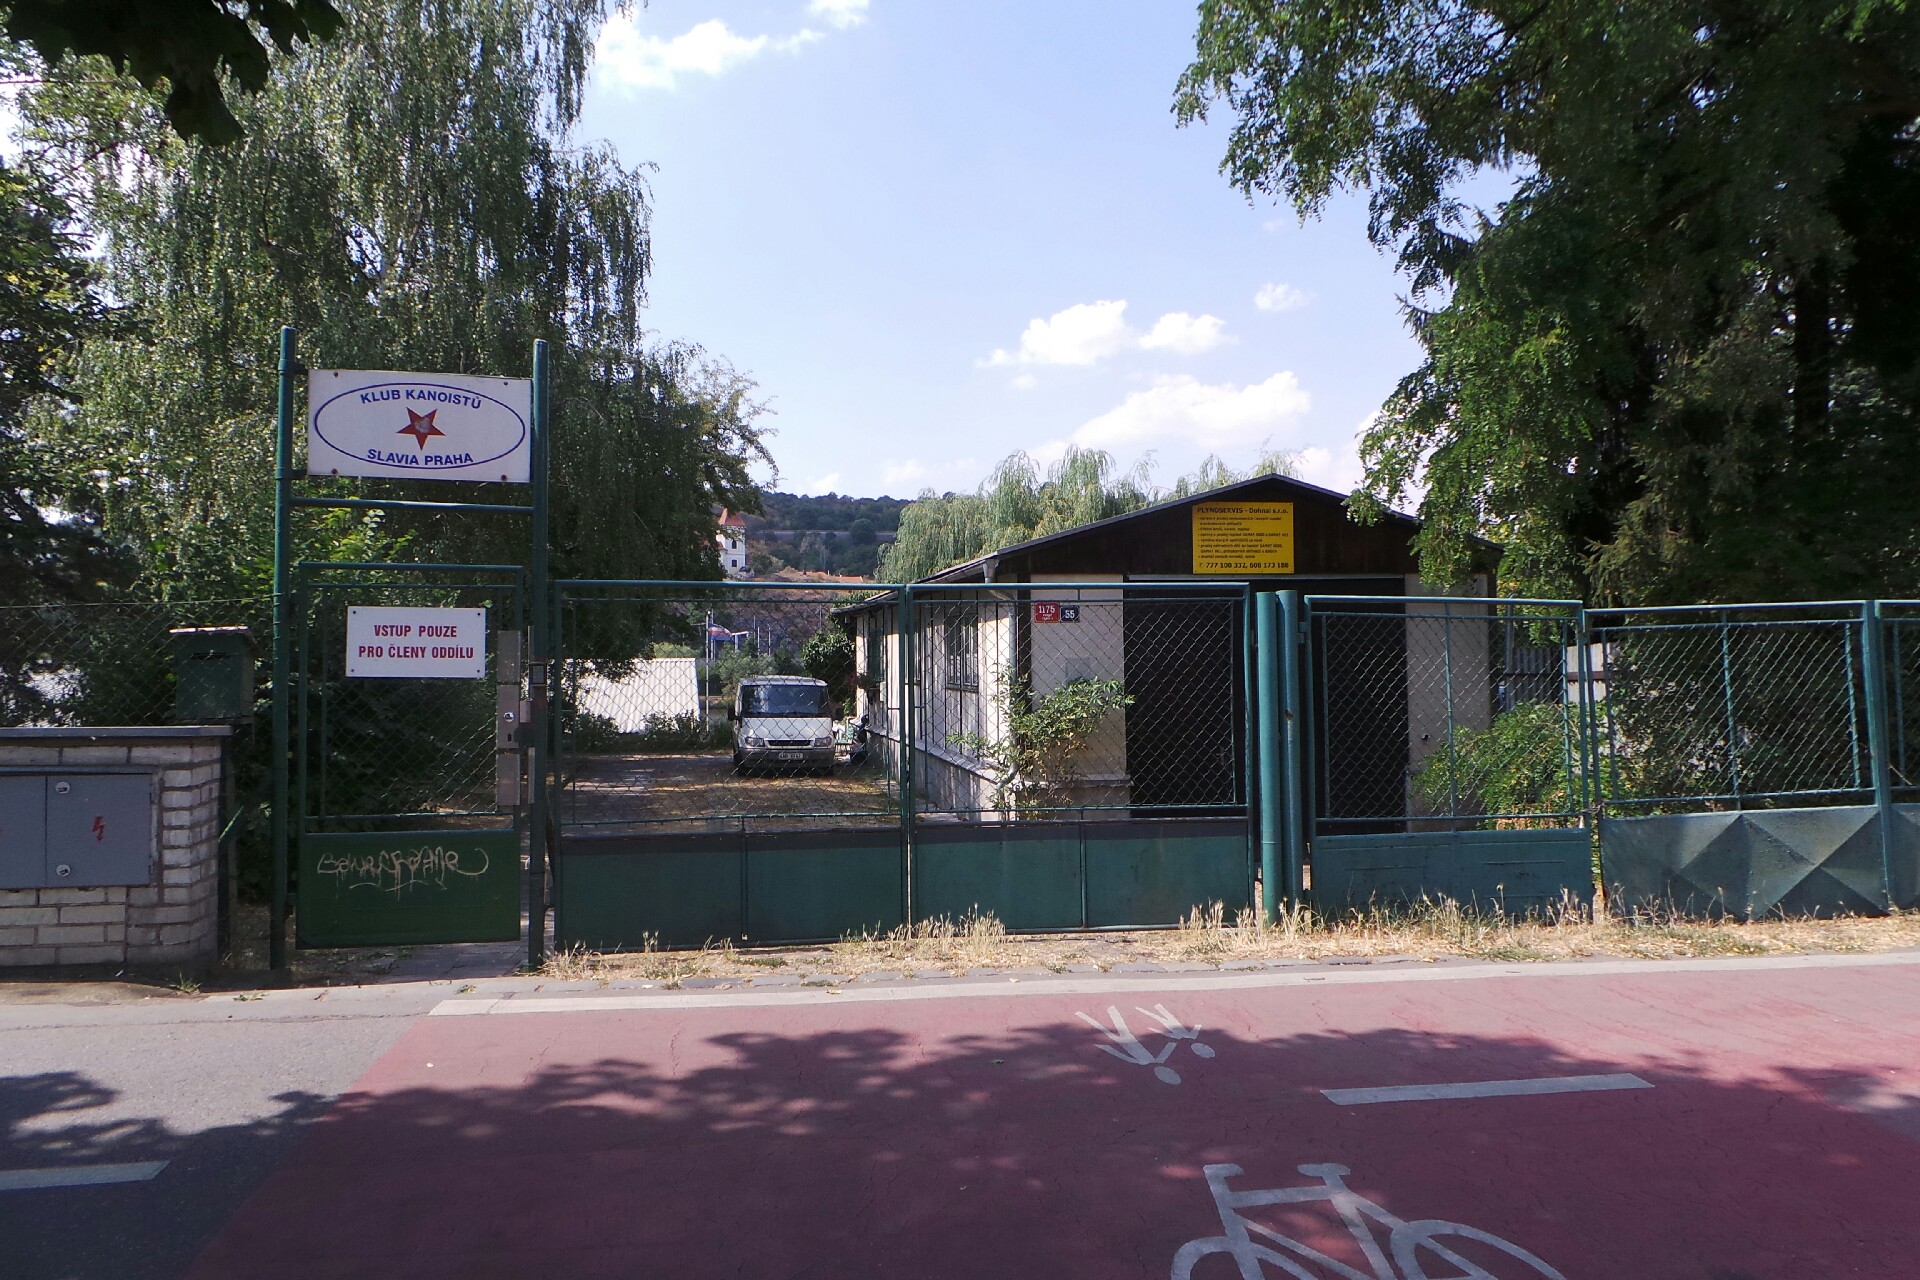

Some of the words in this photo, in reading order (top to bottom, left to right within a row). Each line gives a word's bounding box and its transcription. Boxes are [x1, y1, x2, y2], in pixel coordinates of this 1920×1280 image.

[360, 389, 401, 404] KLUB
[405, 389, 482, 410] KANOISTŮ
[367, 448, 419, 465] SLAVIA
[424, 452, 474, 466] PRAHA
[1038, 605, 1056, 614] 1175
[1065, 609, 1075, 619] 55
[374, 624, 412, 637] VSTUP
[418, 625, 457, 638] POUZE
[358, 645, 383, 658] PRO
[388, 643, 427, 659] ČLENY
[431, 643, 474, 659] ODDÍLU
